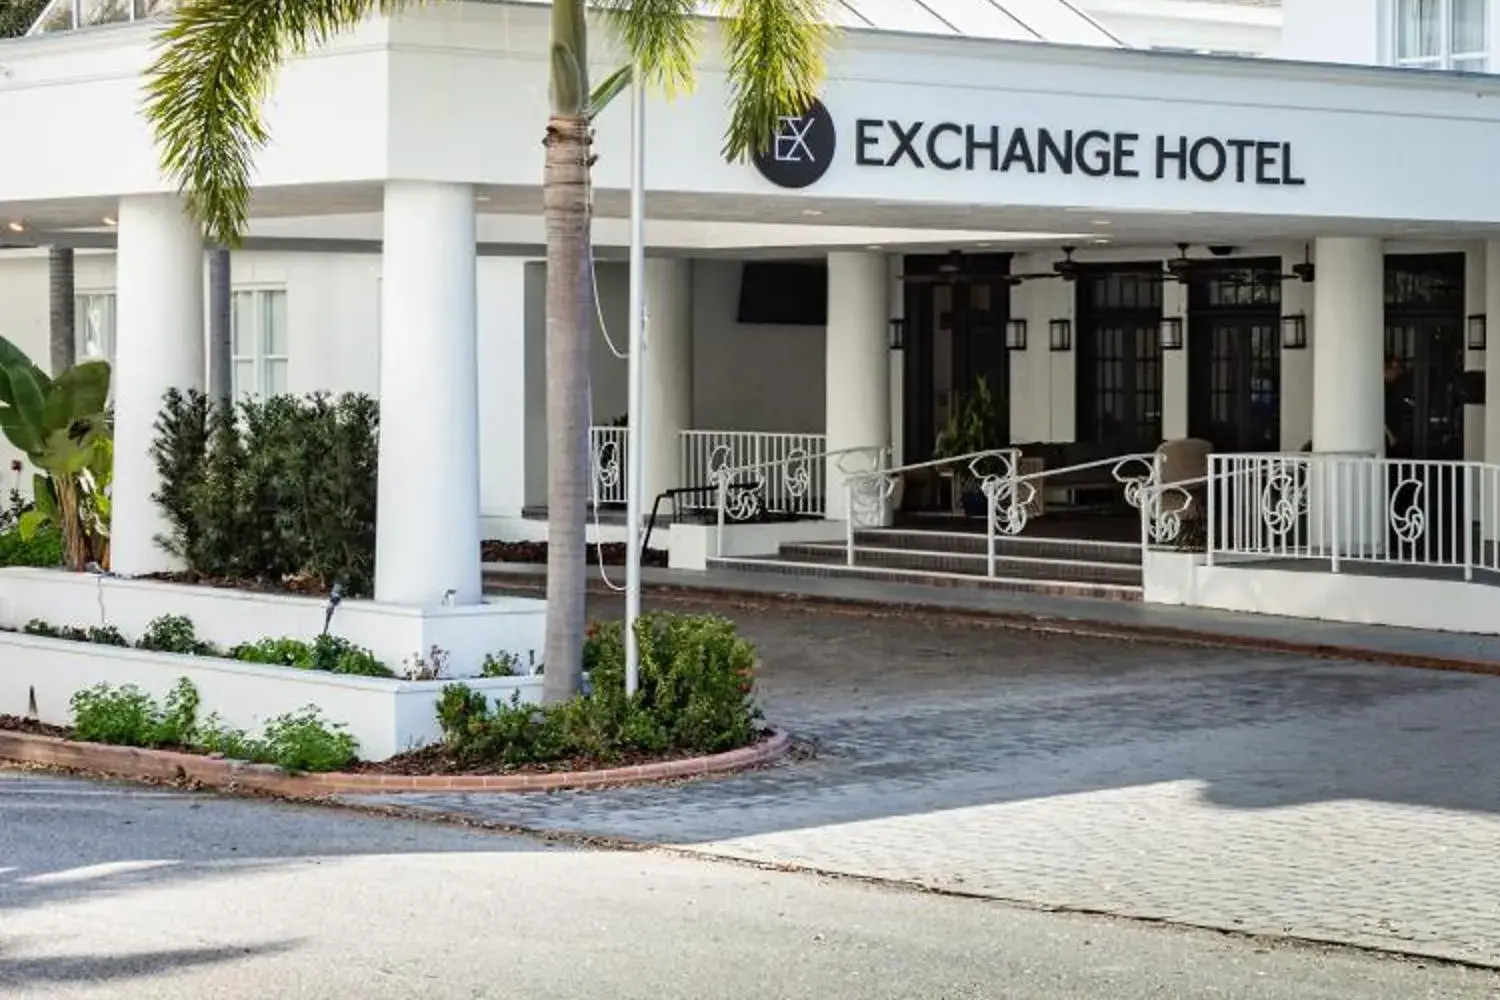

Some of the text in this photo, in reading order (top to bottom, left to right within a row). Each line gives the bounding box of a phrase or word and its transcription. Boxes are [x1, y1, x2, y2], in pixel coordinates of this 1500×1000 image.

[775, 115, 816, 162] EX
[855, 119, 1305, 186] EXCHANGE HOTEL
